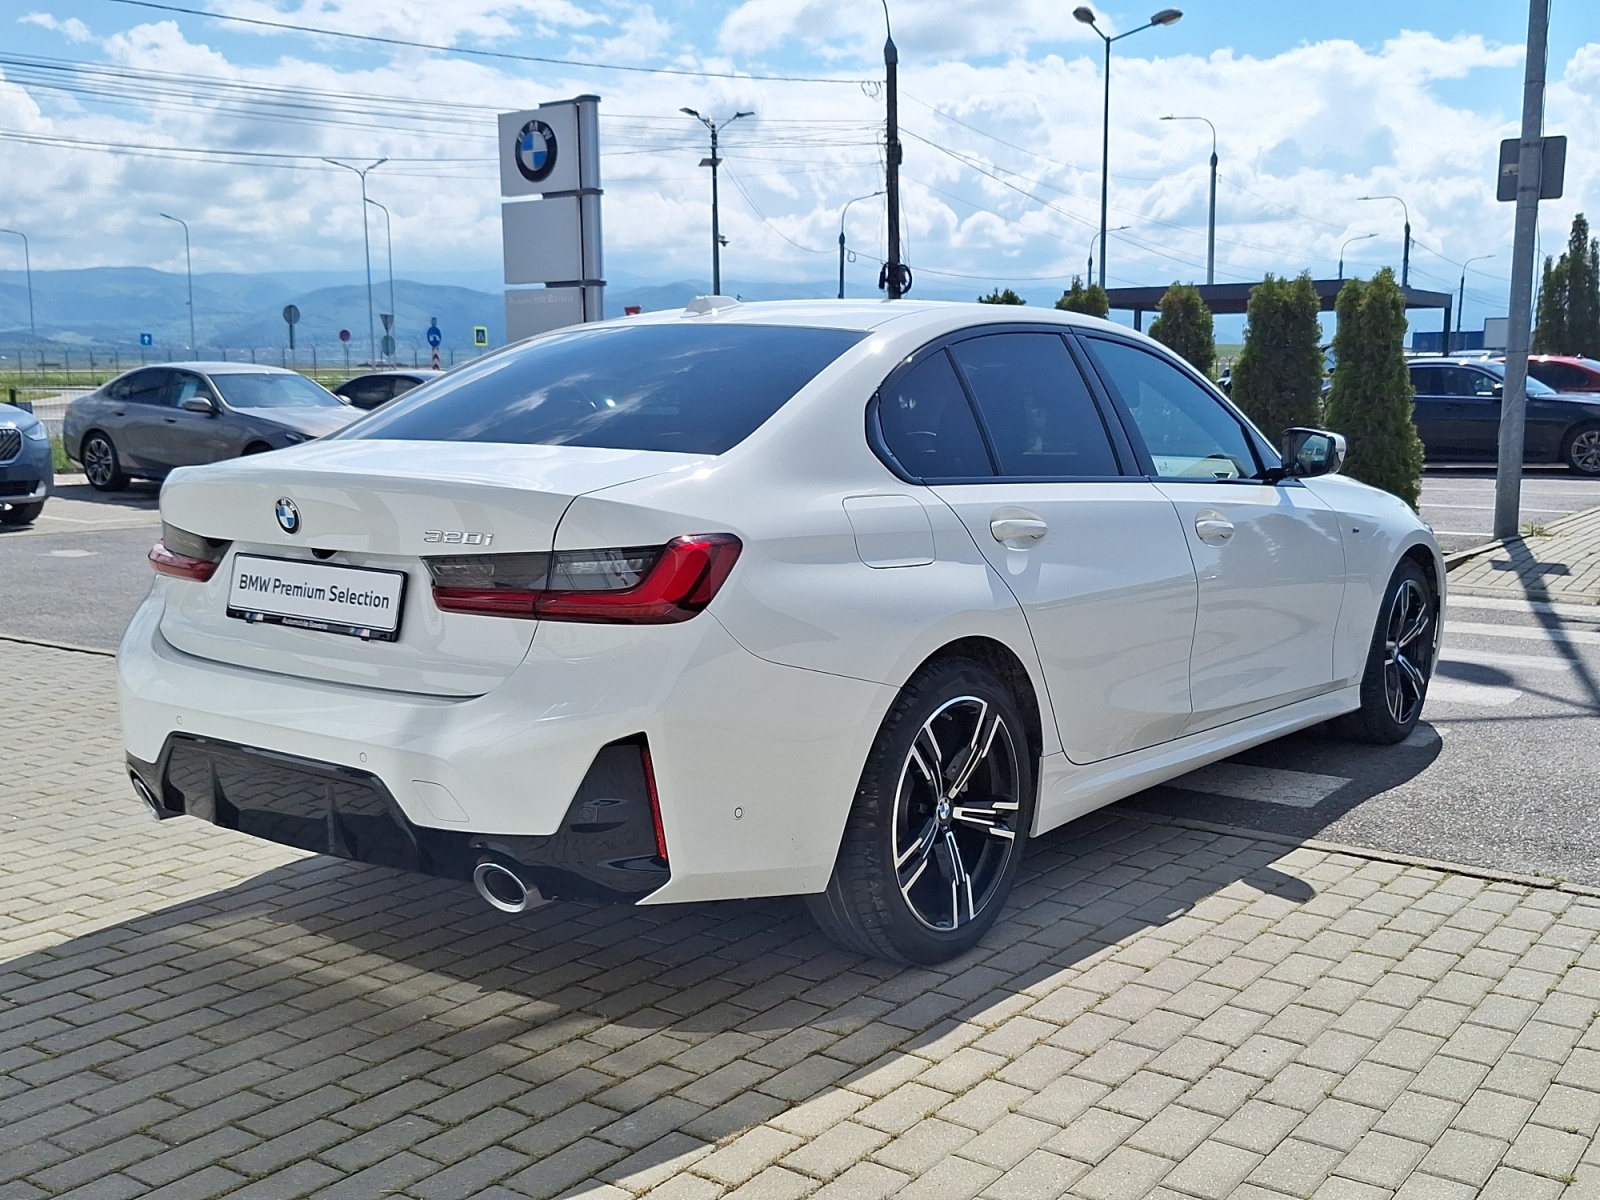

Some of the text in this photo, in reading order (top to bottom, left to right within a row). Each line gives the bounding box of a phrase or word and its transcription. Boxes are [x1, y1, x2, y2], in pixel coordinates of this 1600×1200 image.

[517, 121, 553, 143] BMW
[423, 529, 494, 546] 320i
[239, 573, 390, 609] BMW Premium Selection
